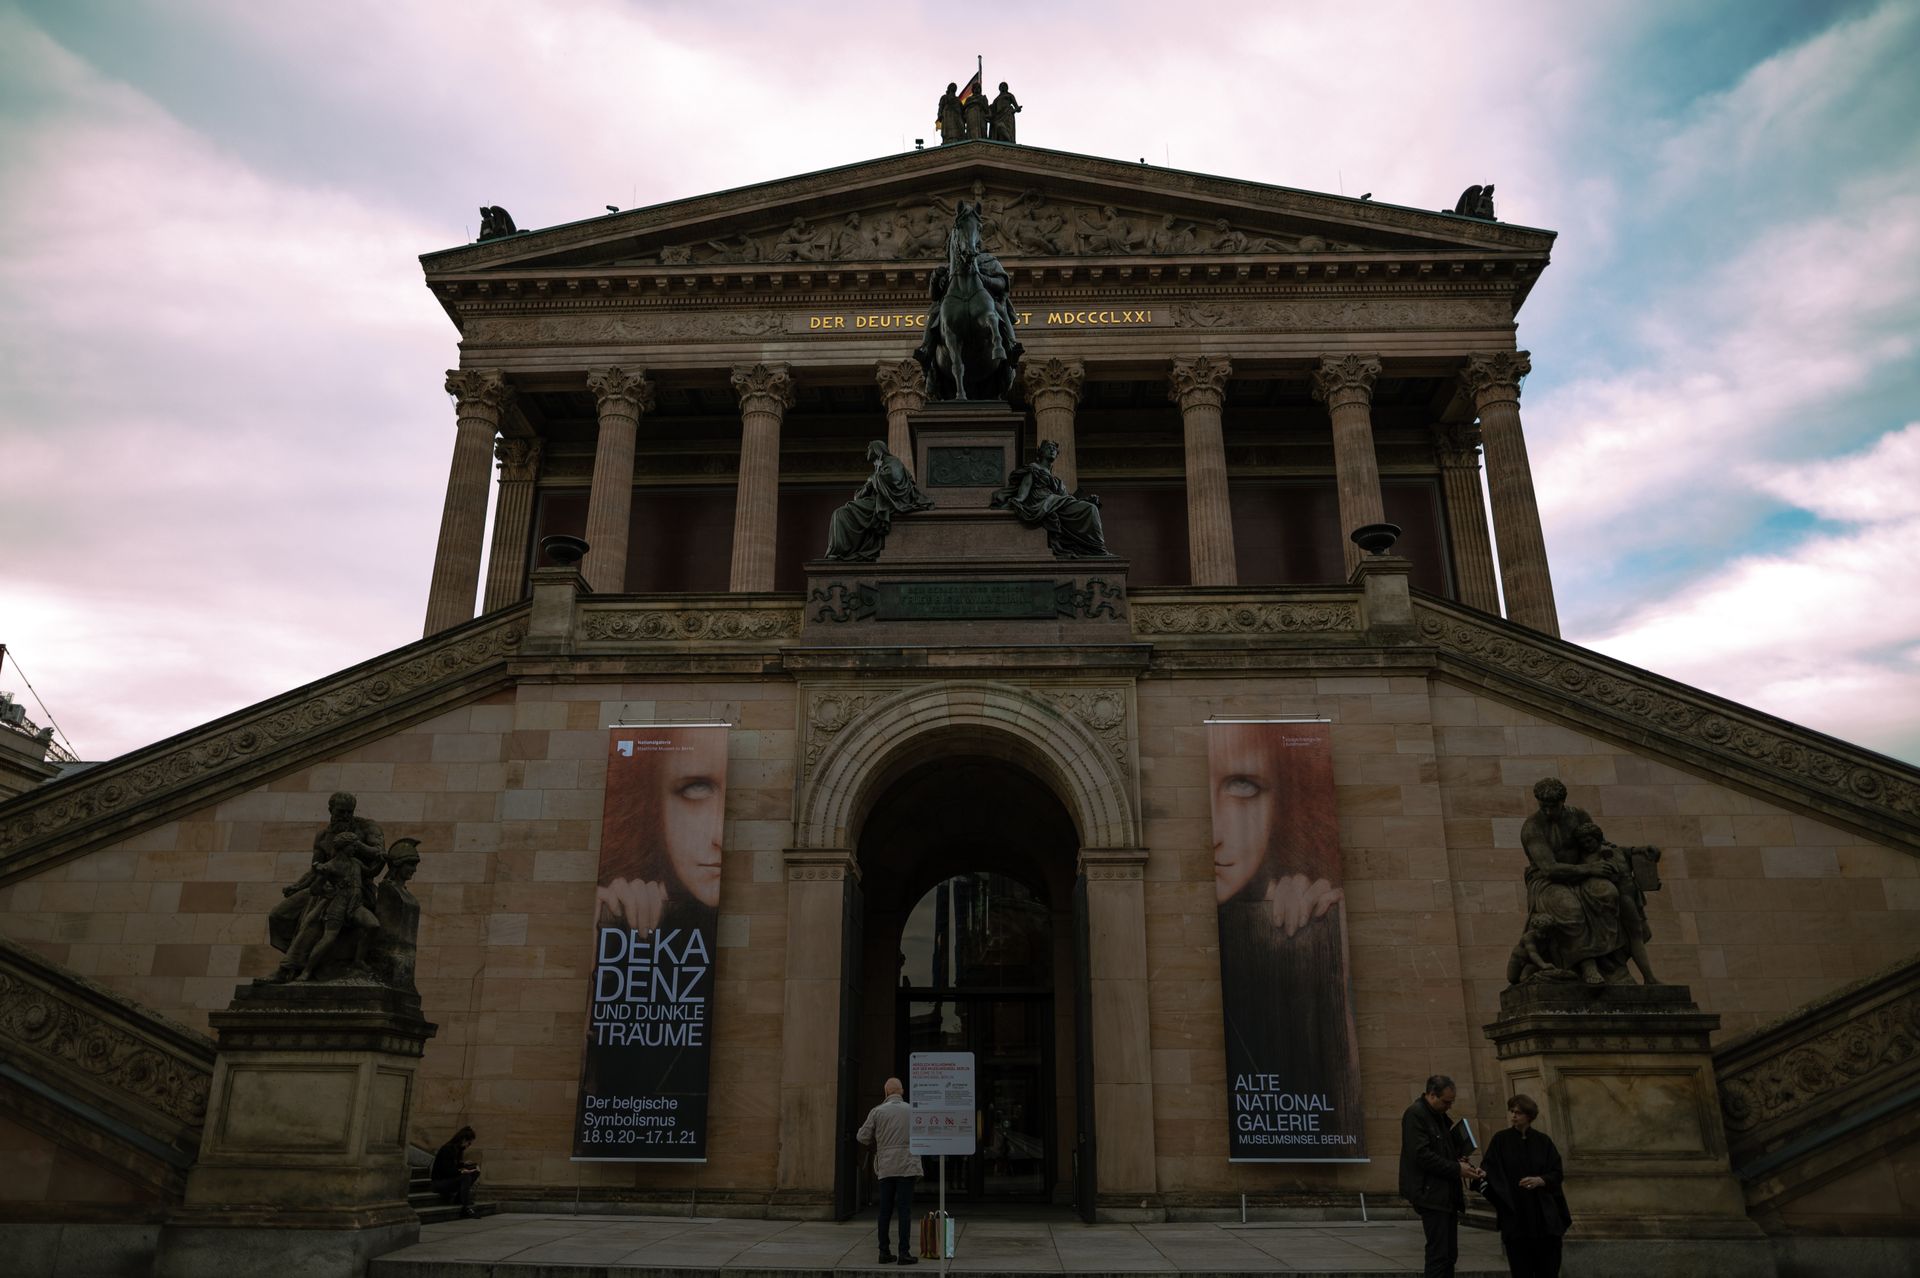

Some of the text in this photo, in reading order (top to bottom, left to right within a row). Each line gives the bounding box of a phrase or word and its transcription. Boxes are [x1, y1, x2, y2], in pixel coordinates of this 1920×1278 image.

[810, 316, 845, 328] DER
[856, 314, 930, 328] DEUTSC
[1047, 310, 1152, 324] MDCCCLXXI
[598, 928, 710, 964] DEKA
[595, 965, 706, 1003] DENZ
[593, 1003, 705, 1020] UND DUNKLE
[593, 1022, 704, 1047] TRÄUME
[1234, 1074, 1281, 1091] ALTE
[585, 1095, 678, 1113] Der belgische
[1236, 1093, 1335, 1111] NATIONAL
[583, 1112, 676, 1129] Symbolismus
[1237, 1114, 1321, 1132] GALERIE
[1239, 1134, 1357, 1145] MUSEUMSINSEL BERLIN
